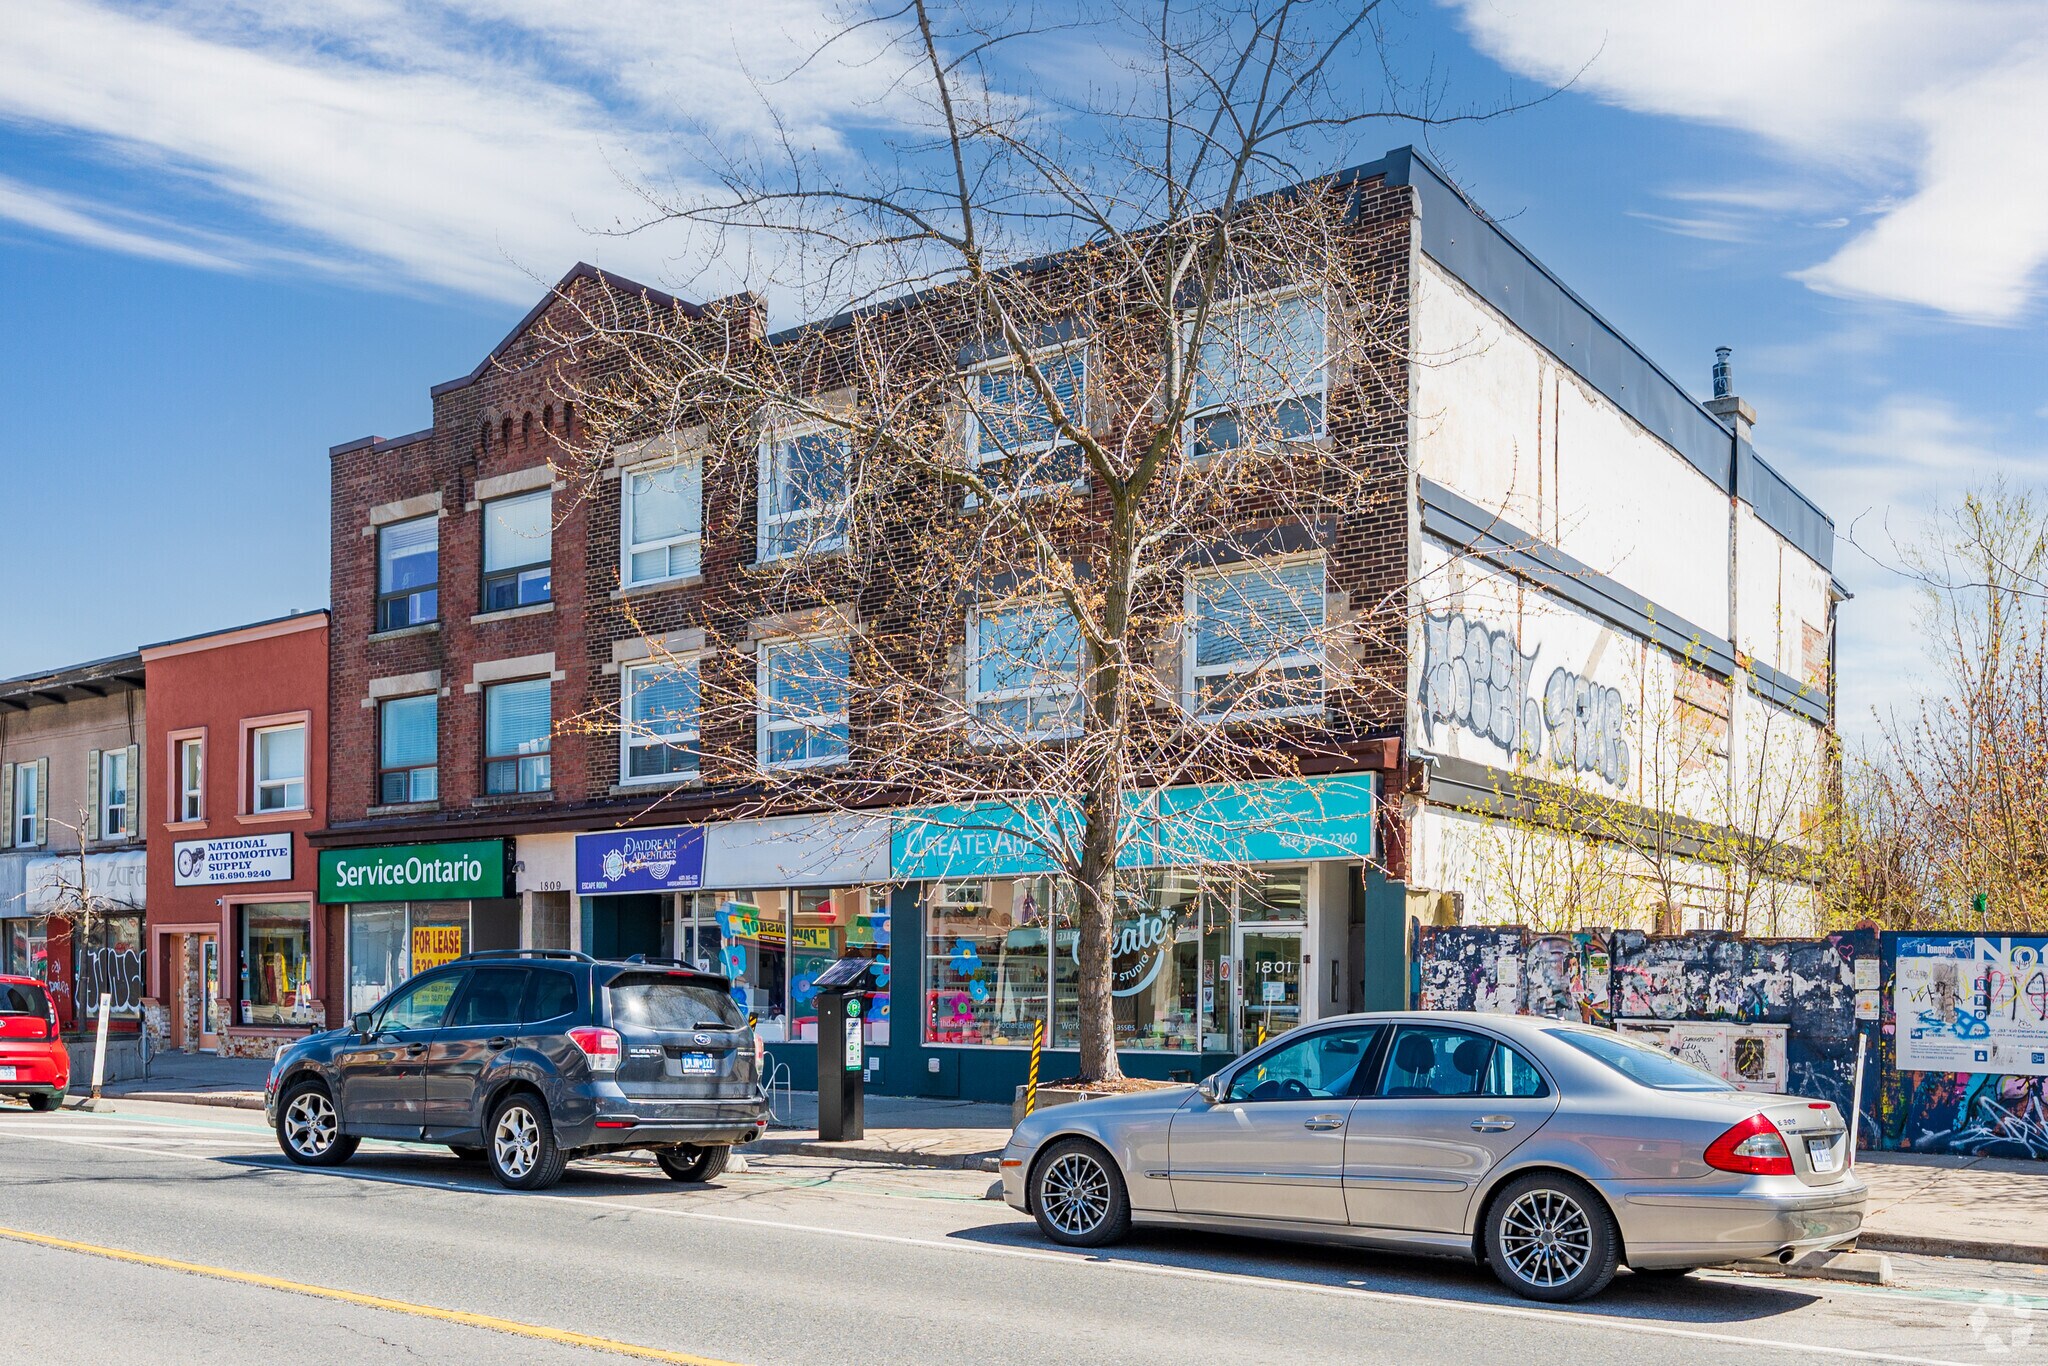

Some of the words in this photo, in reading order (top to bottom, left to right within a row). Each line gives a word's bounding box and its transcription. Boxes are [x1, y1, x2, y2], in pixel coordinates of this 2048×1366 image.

[208, 839, 267, 851] NATIONAL
[623, 837, 677, 856] DAYDREAM
[208, 848, 288, 861] AUTOMOTIVE
[632, 850, 677, 861] ADVENTURES
[208, 861, 252, 872] SUPPLY
[336, 854, 482, 887] ServiceOntario
[209, 869, 272, 880] 416.690.9240
[540, 881, 562, 890] 1809
[581, 882, 596, 890] ESCAPE
[596, 881, 608, 889] ROOM
[414, 930, 431, 954] FOR
[433, 930, 460, 954] LEASE
[1119, 953, 1150, 982] STUDIO
[1255, 961, 1292, 973] 1801
[1113, 1022, 1136, 1031] lasses
